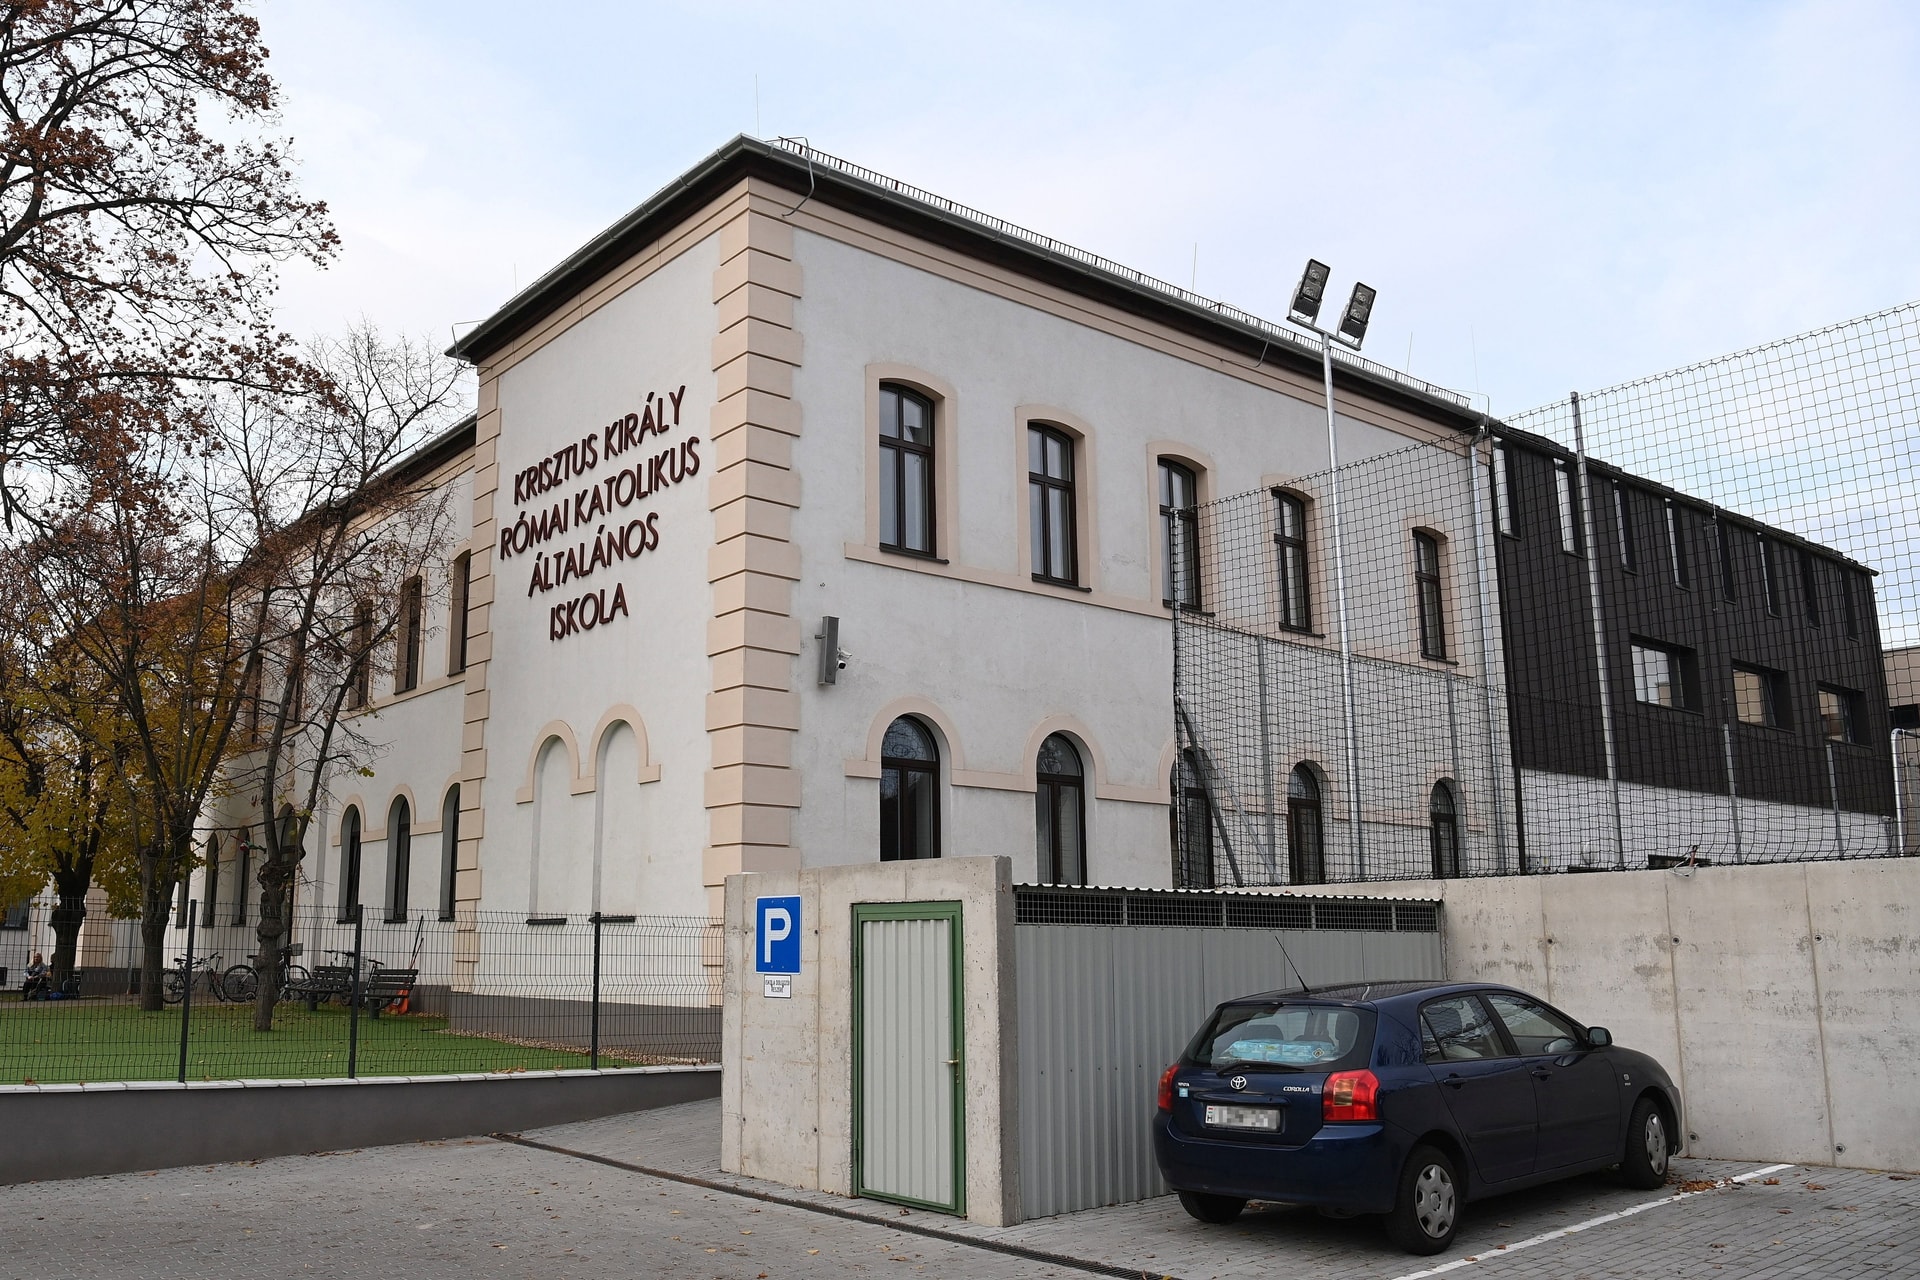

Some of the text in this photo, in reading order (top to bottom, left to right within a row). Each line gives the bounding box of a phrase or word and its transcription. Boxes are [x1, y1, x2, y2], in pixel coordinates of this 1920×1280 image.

[514, 385, 686, 505] KRISZTUS KIRÁLY
[500, 436, 700, 560] RÓMAI KATOLIKUS
[528, 512, 659, 598] ÁLTALÁNOS
[550, 582, 628, 641] ISKOLA
[765, 908, 791, 963] P
